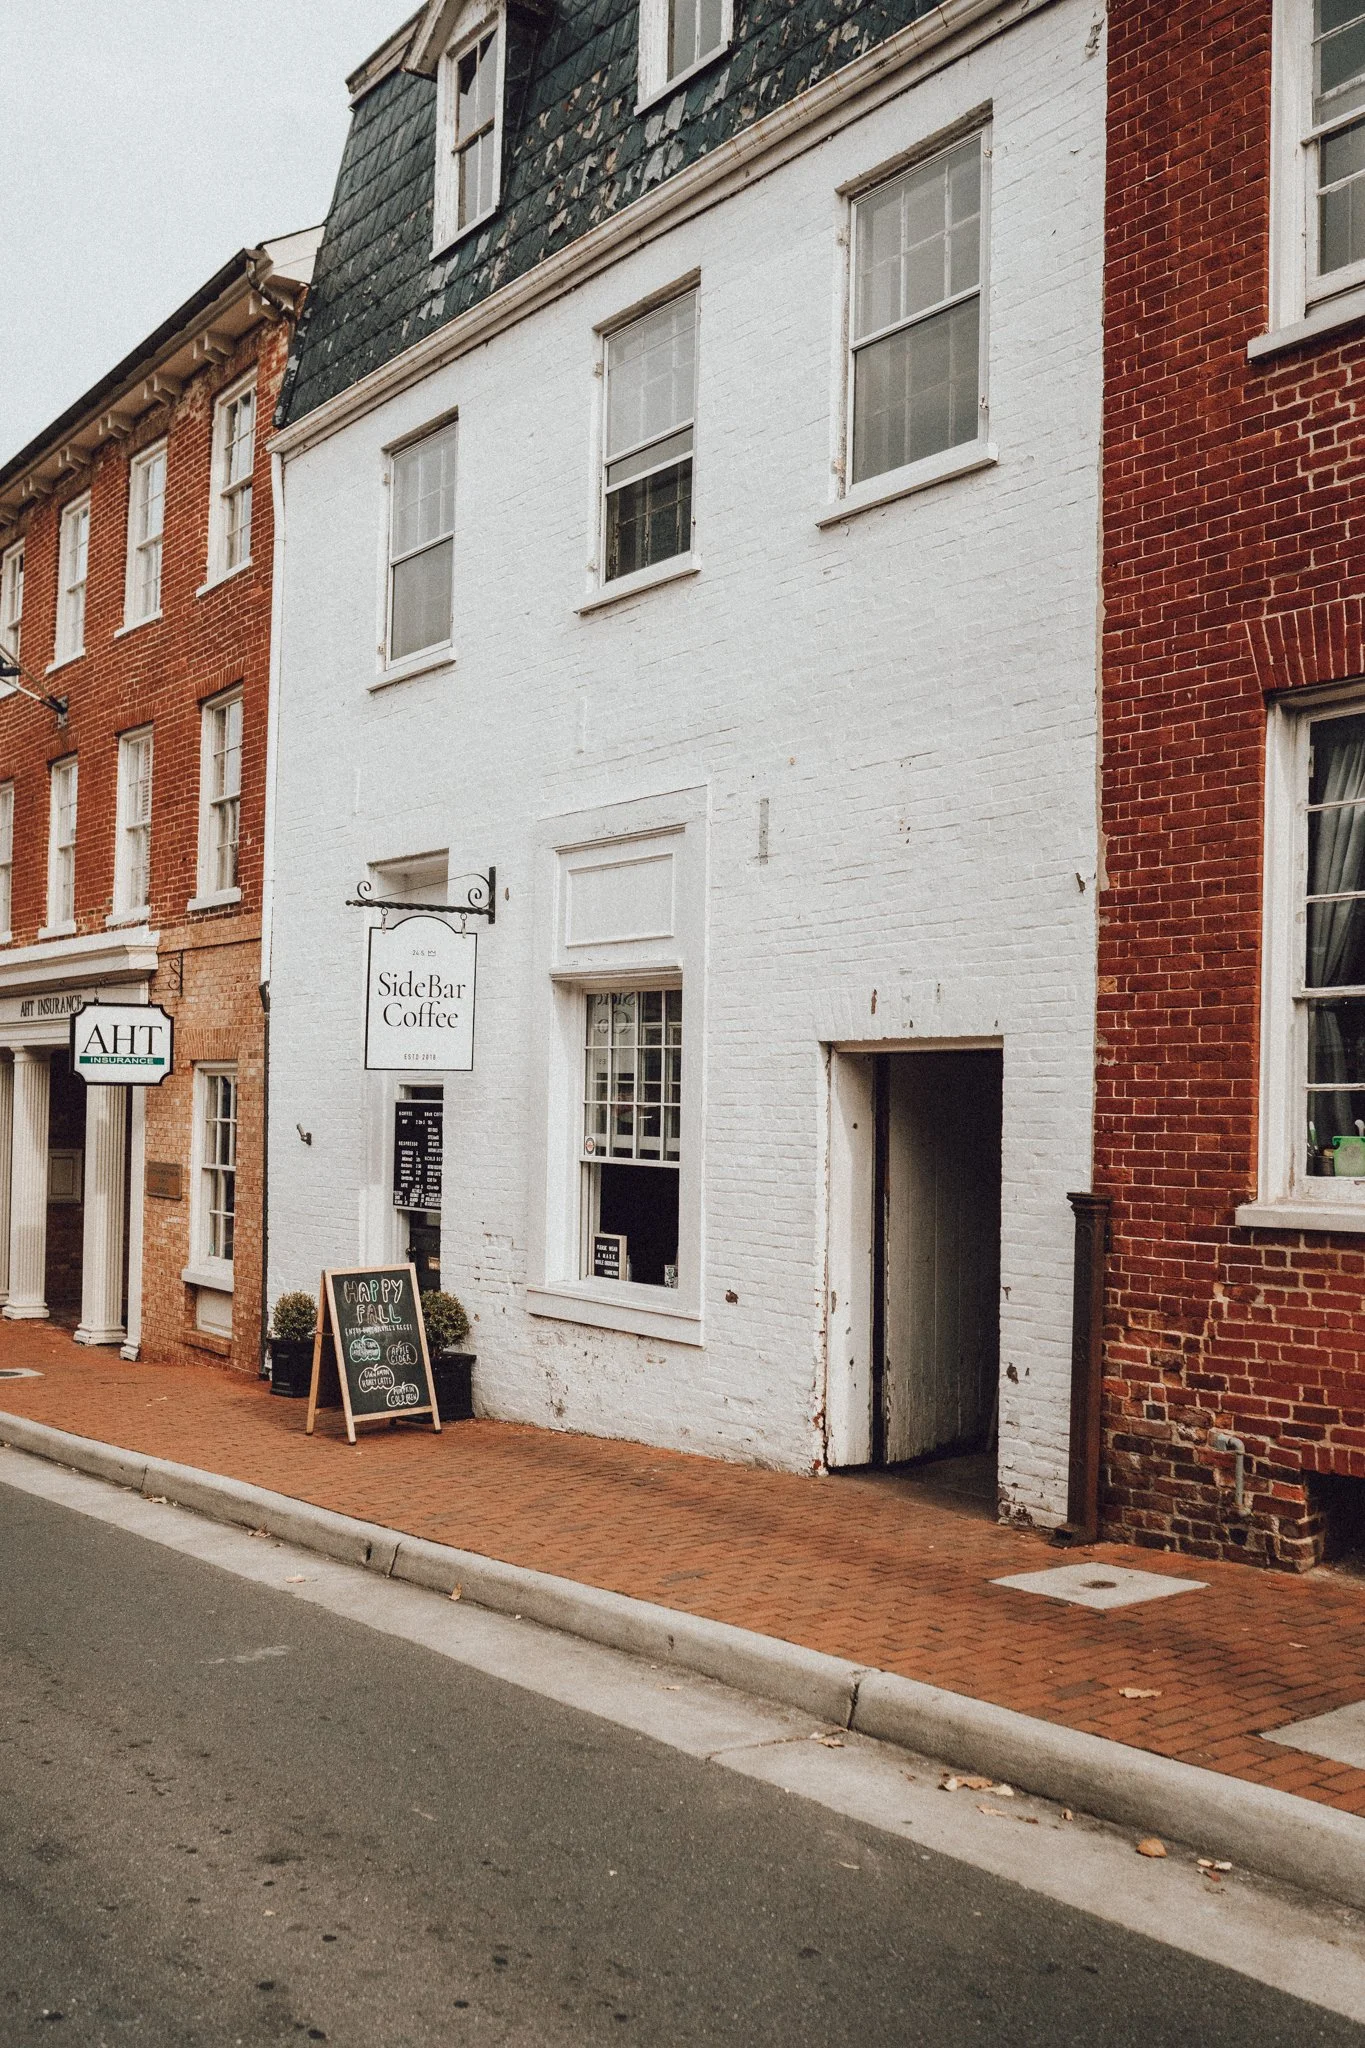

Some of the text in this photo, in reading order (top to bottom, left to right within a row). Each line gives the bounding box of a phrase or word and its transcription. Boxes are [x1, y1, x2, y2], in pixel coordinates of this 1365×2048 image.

[378, 970, 466, 999] SideBar
[20, 1002, 34, 1017] AHT
[383, 1001, 459, 1029] Coffee
[81, 1023, 163, 1055] AHT
[90, 1056, 154, 1065] INSURANCE
[343, 1278, 403, 1304] HAPPY
[356, 1304, 401, 1324] FALL
[390, 1353, 411, 1363] CIDER
[391, 1345, 409, 1356] APPLE
[390, 1393, 405, 1405] COLD
